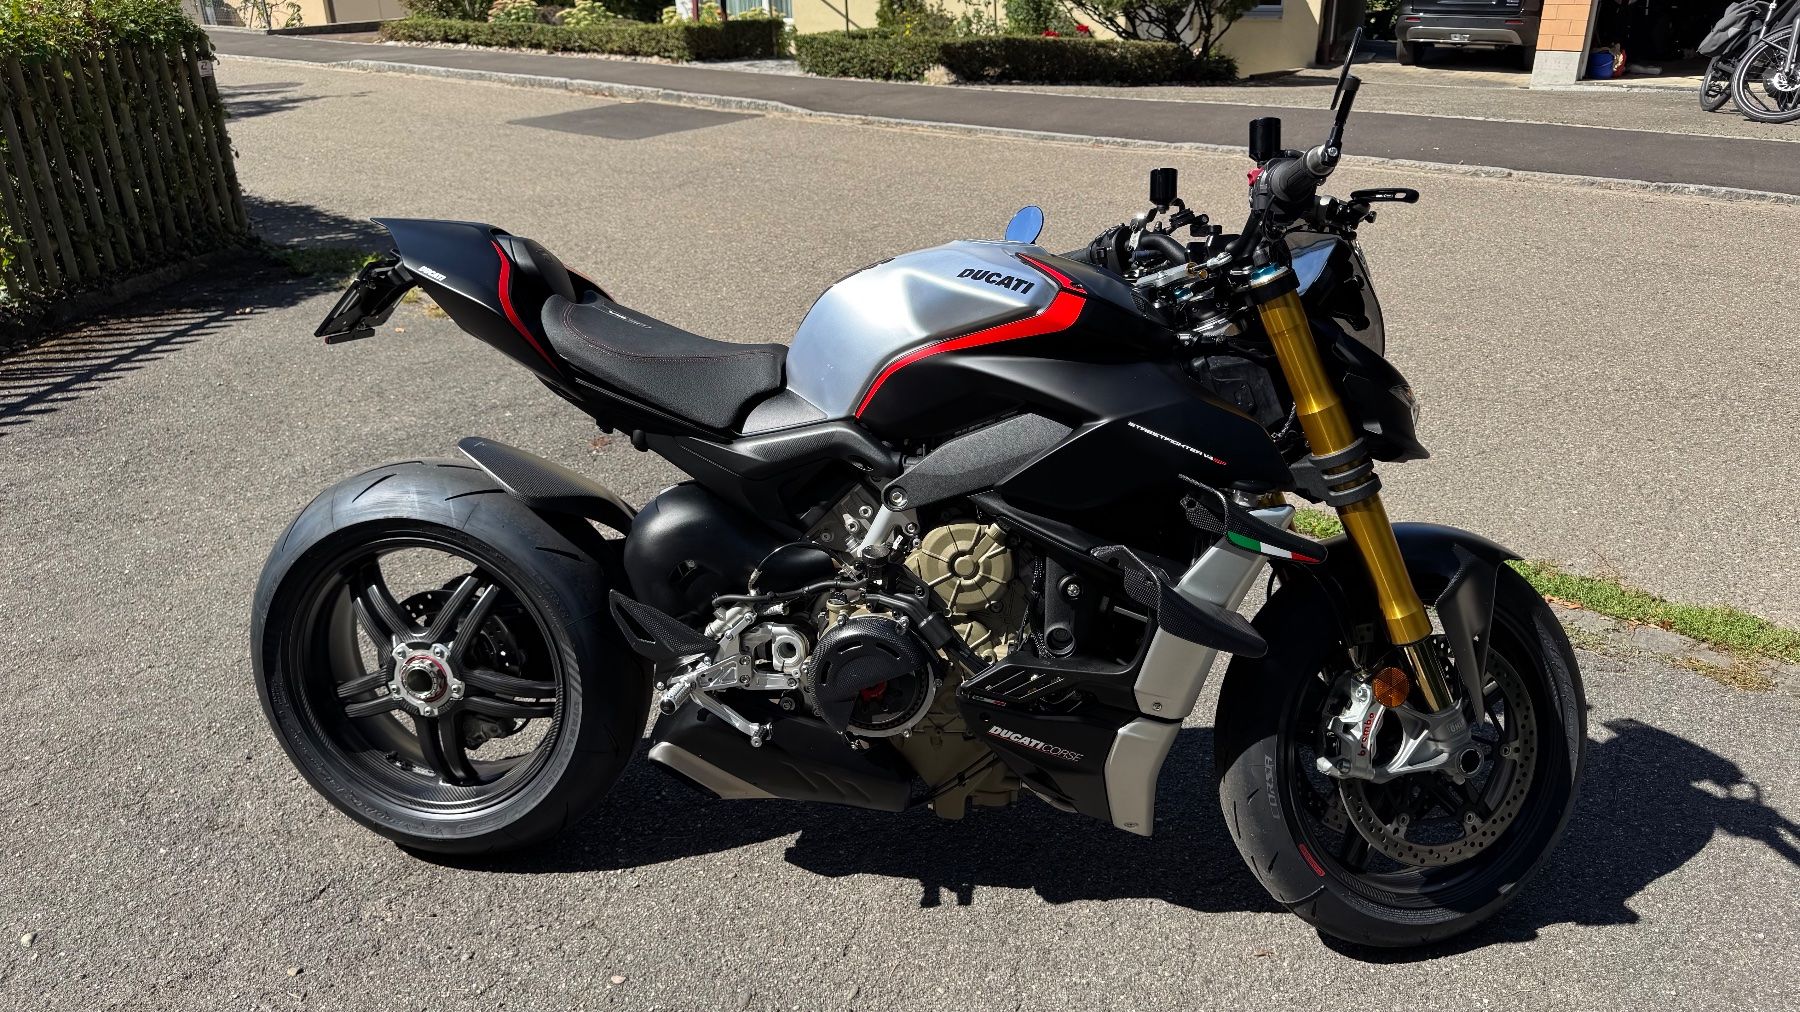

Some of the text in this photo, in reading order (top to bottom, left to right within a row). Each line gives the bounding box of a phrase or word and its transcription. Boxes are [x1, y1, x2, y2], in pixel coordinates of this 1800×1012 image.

[956, 268, 1035, 295] DUCATI
[988, 725, 1084, 762] DUCATI CORSE
[1358, 712, 1375, 757] brembo
[1264, 754, 1281, 819] CORSA
